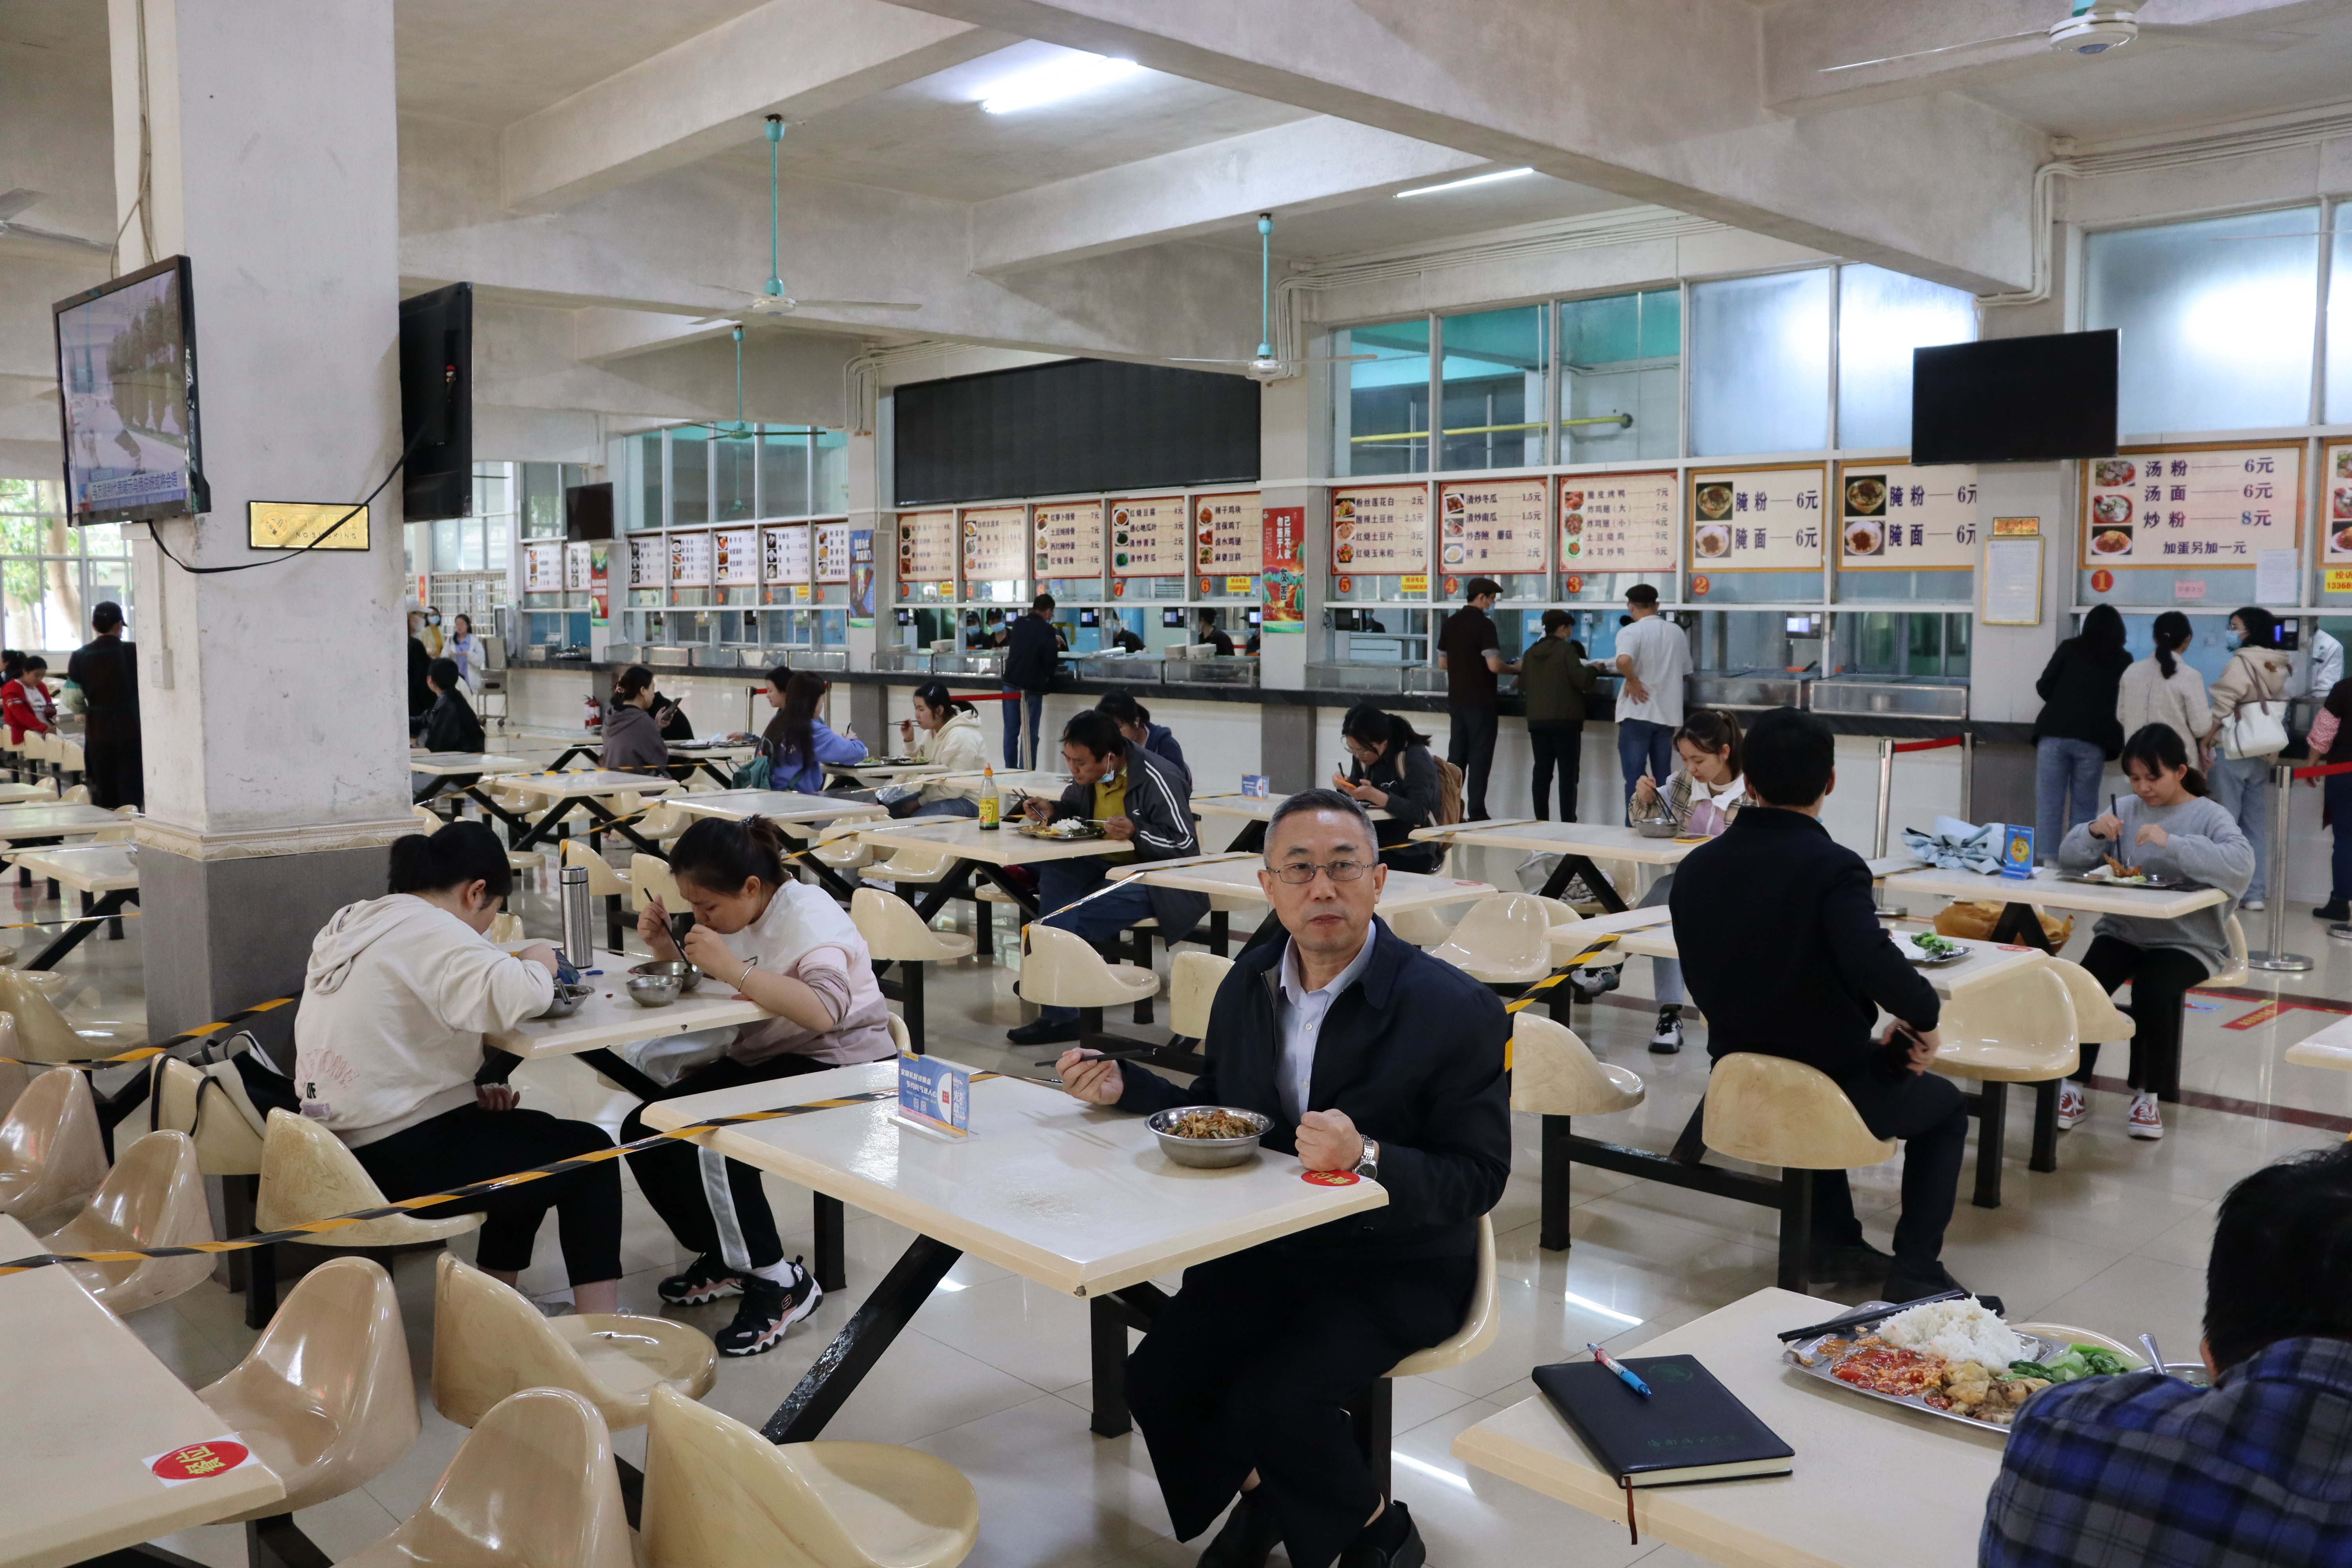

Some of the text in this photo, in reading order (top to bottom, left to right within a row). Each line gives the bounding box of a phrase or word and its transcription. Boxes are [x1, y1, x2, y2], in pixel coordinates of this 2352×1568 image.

[2145, 457, 2274, 477] 汤粉 6元
[1466, 492, 1541, 504] 清炒冬瓜 1.5元
[1657, 488, 1668, 496] 7元
[1889, 484, 1978, 508] 腌粉 6元
[2144, 482, 2273, 502] 汤面 6元
[1356, 495, 1424, 507] 粉丝莲花白 2元
[1735, 489, 1818, 513] 腌粉 6元
[1130, 508, 1156, 517] 红烧豆腐
[1216, 506, 1241, 514] 辣子鸡块
[1466, 510, 1541, 523] 清炒南瓜 1.5元
[1215, 521, 1241, 530] 宫保鸡丁
[1356, 513, 1424, 524] 酸辣土豆丝 2.5元
[1656, 518, 1668, 526] 6元
[2143, 510, 2272, 528] 炒粉 8元
[1356, 531, 1423, 541] 红烧土豆片 3元
[1655, 532, 1668, 540] 5元
[1735, 526, 1818, 550] 腌面 6元
[1888, 523, 1924, 547] 腌面
[1956, 522, 1976, 545] 6元
[1129, 537, 1183, 548] 清炒青菜 2元
[2163, 541, 2247, 555] 加蛋另加一元
[1130, 553, 1183, 562] 清炒苦瓜 2元
[1356, 548, 1423, 558] 红烧玉米粒 3元
[1527, 548, 1540, 557] 2元
[1655, 547, 1667, 555] 5元
[1201, 578, 1210, 592] 6
[1280, 568, 1289, 601] 友善
[1341, 577, 1349, 593] 5
[1445, 577, 1455, 593] 4
[1569, 576, 1580, 592] 3
[1695, 577, 1708, 594] 2
[2095, 571, 2109, 590] 1
[906, 1080, 937, 1098] 节约风气进人心
[175, 1445, 227, 1475] 餐位
